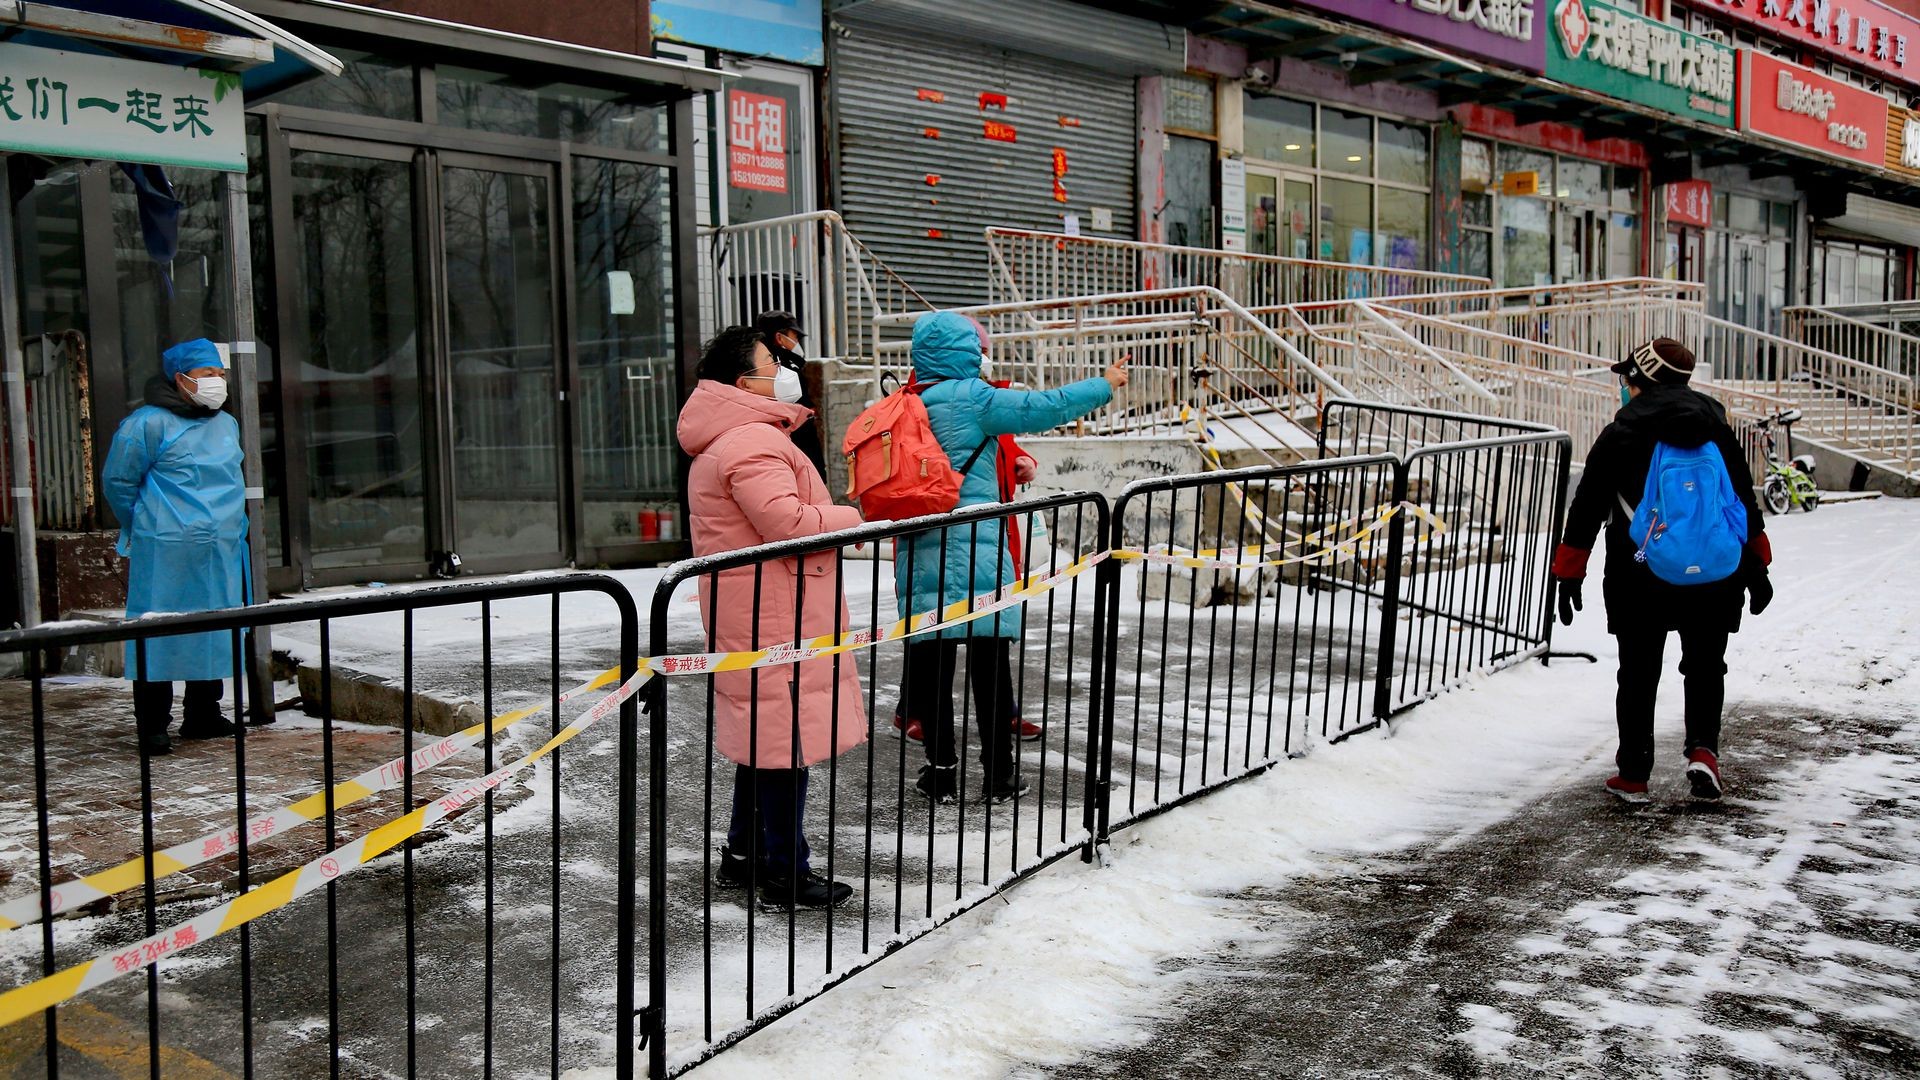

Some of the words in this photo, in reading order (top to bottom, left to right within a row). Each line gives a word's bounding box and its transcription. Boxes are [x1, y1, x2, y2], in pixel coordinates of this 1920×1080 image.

[732, 96, 784, 153] 出租
[662, 656, 708, 674] 警戒线
[112, 925, 199, 973] 警戒线
